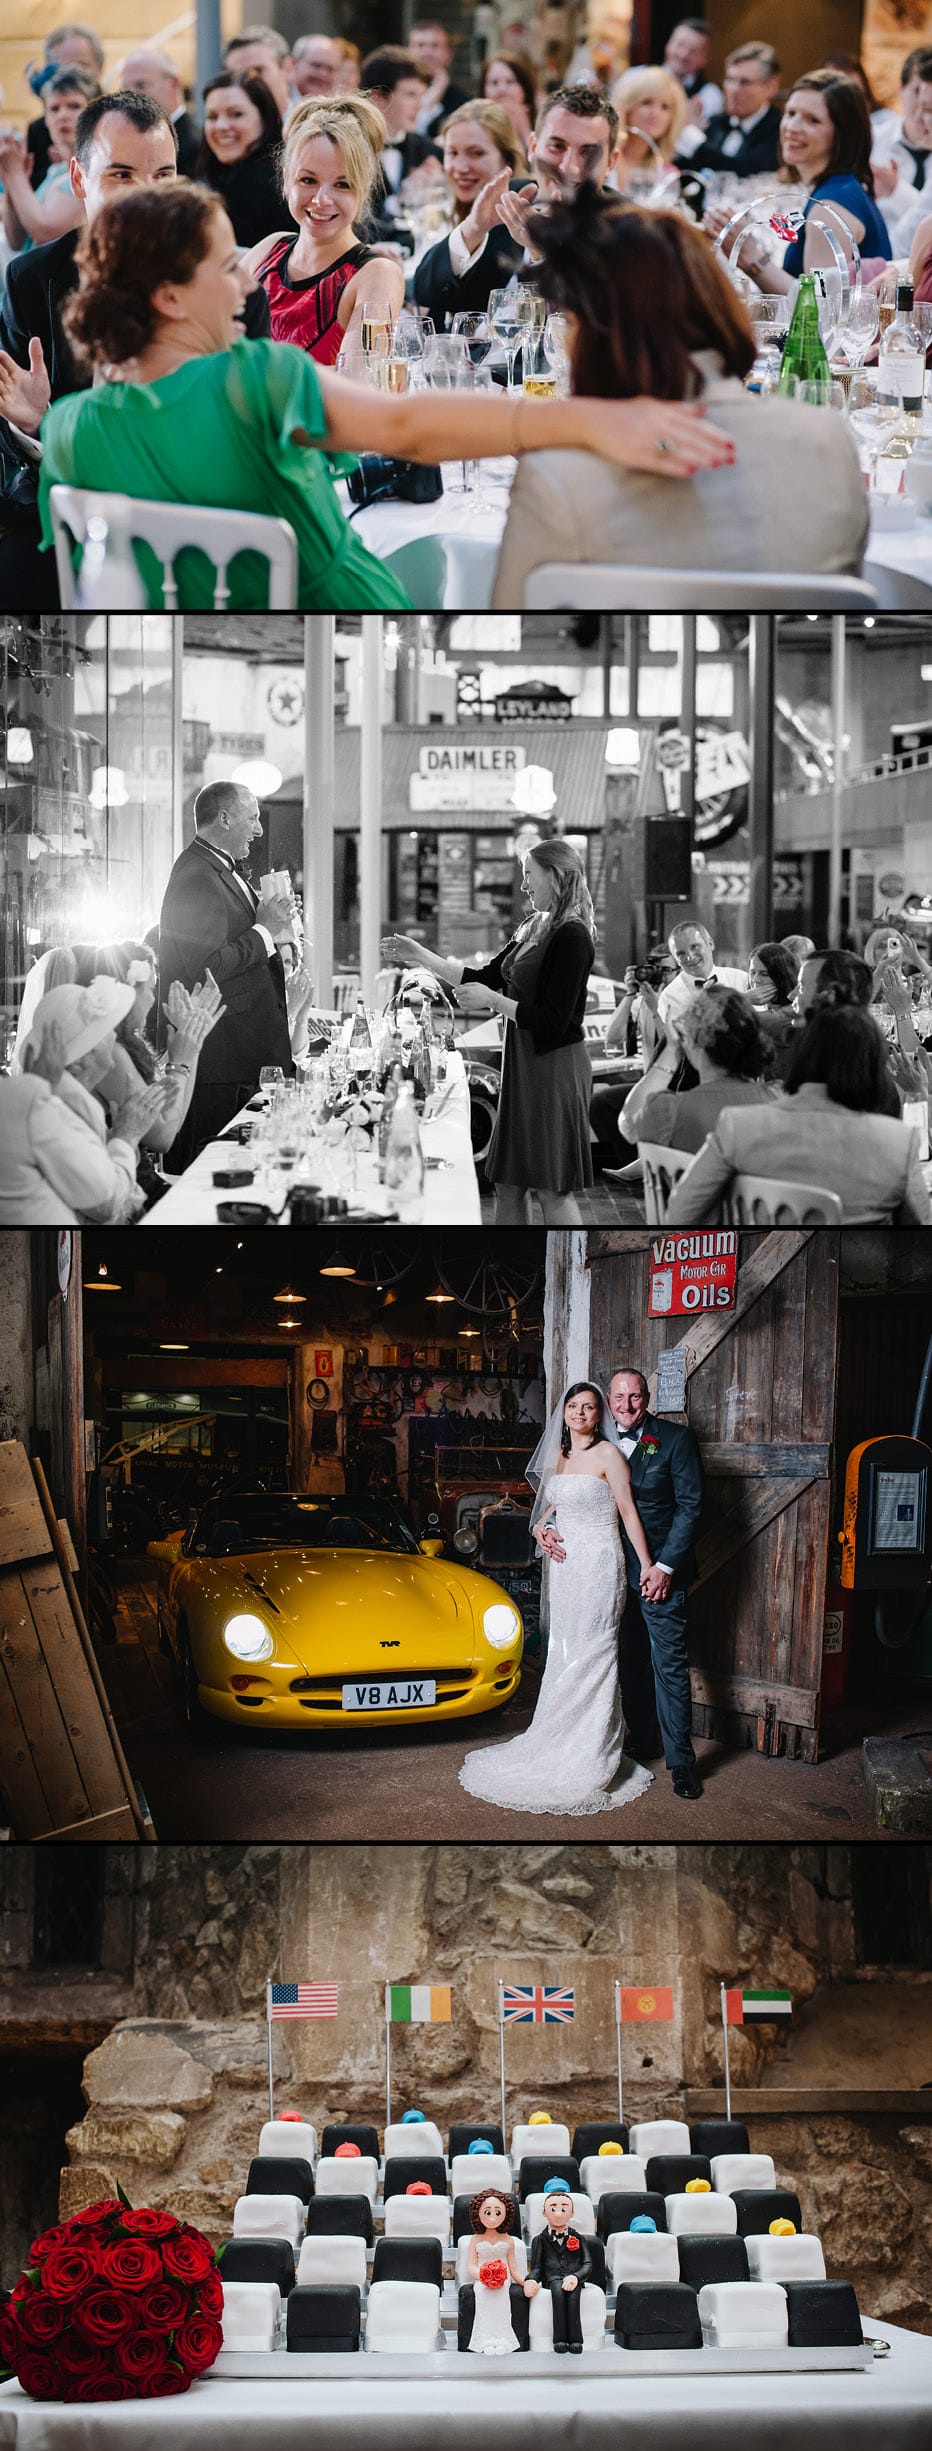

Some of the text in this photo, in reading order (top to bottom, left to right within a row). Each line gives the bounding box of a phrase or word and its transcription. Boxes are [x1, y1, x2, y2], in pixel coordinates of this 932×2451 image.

[497, 700, 571, 717] LEYLAND
[427, 750, 517, 770] DAIMLER
[652, 1231, 736, 1265] Vacuum
[680, 1261, 727, 1281] MOTOR CAR
[681, 1283, 731, 1309] Oils
[356, 1684, 424, 1705] V8 AJX
